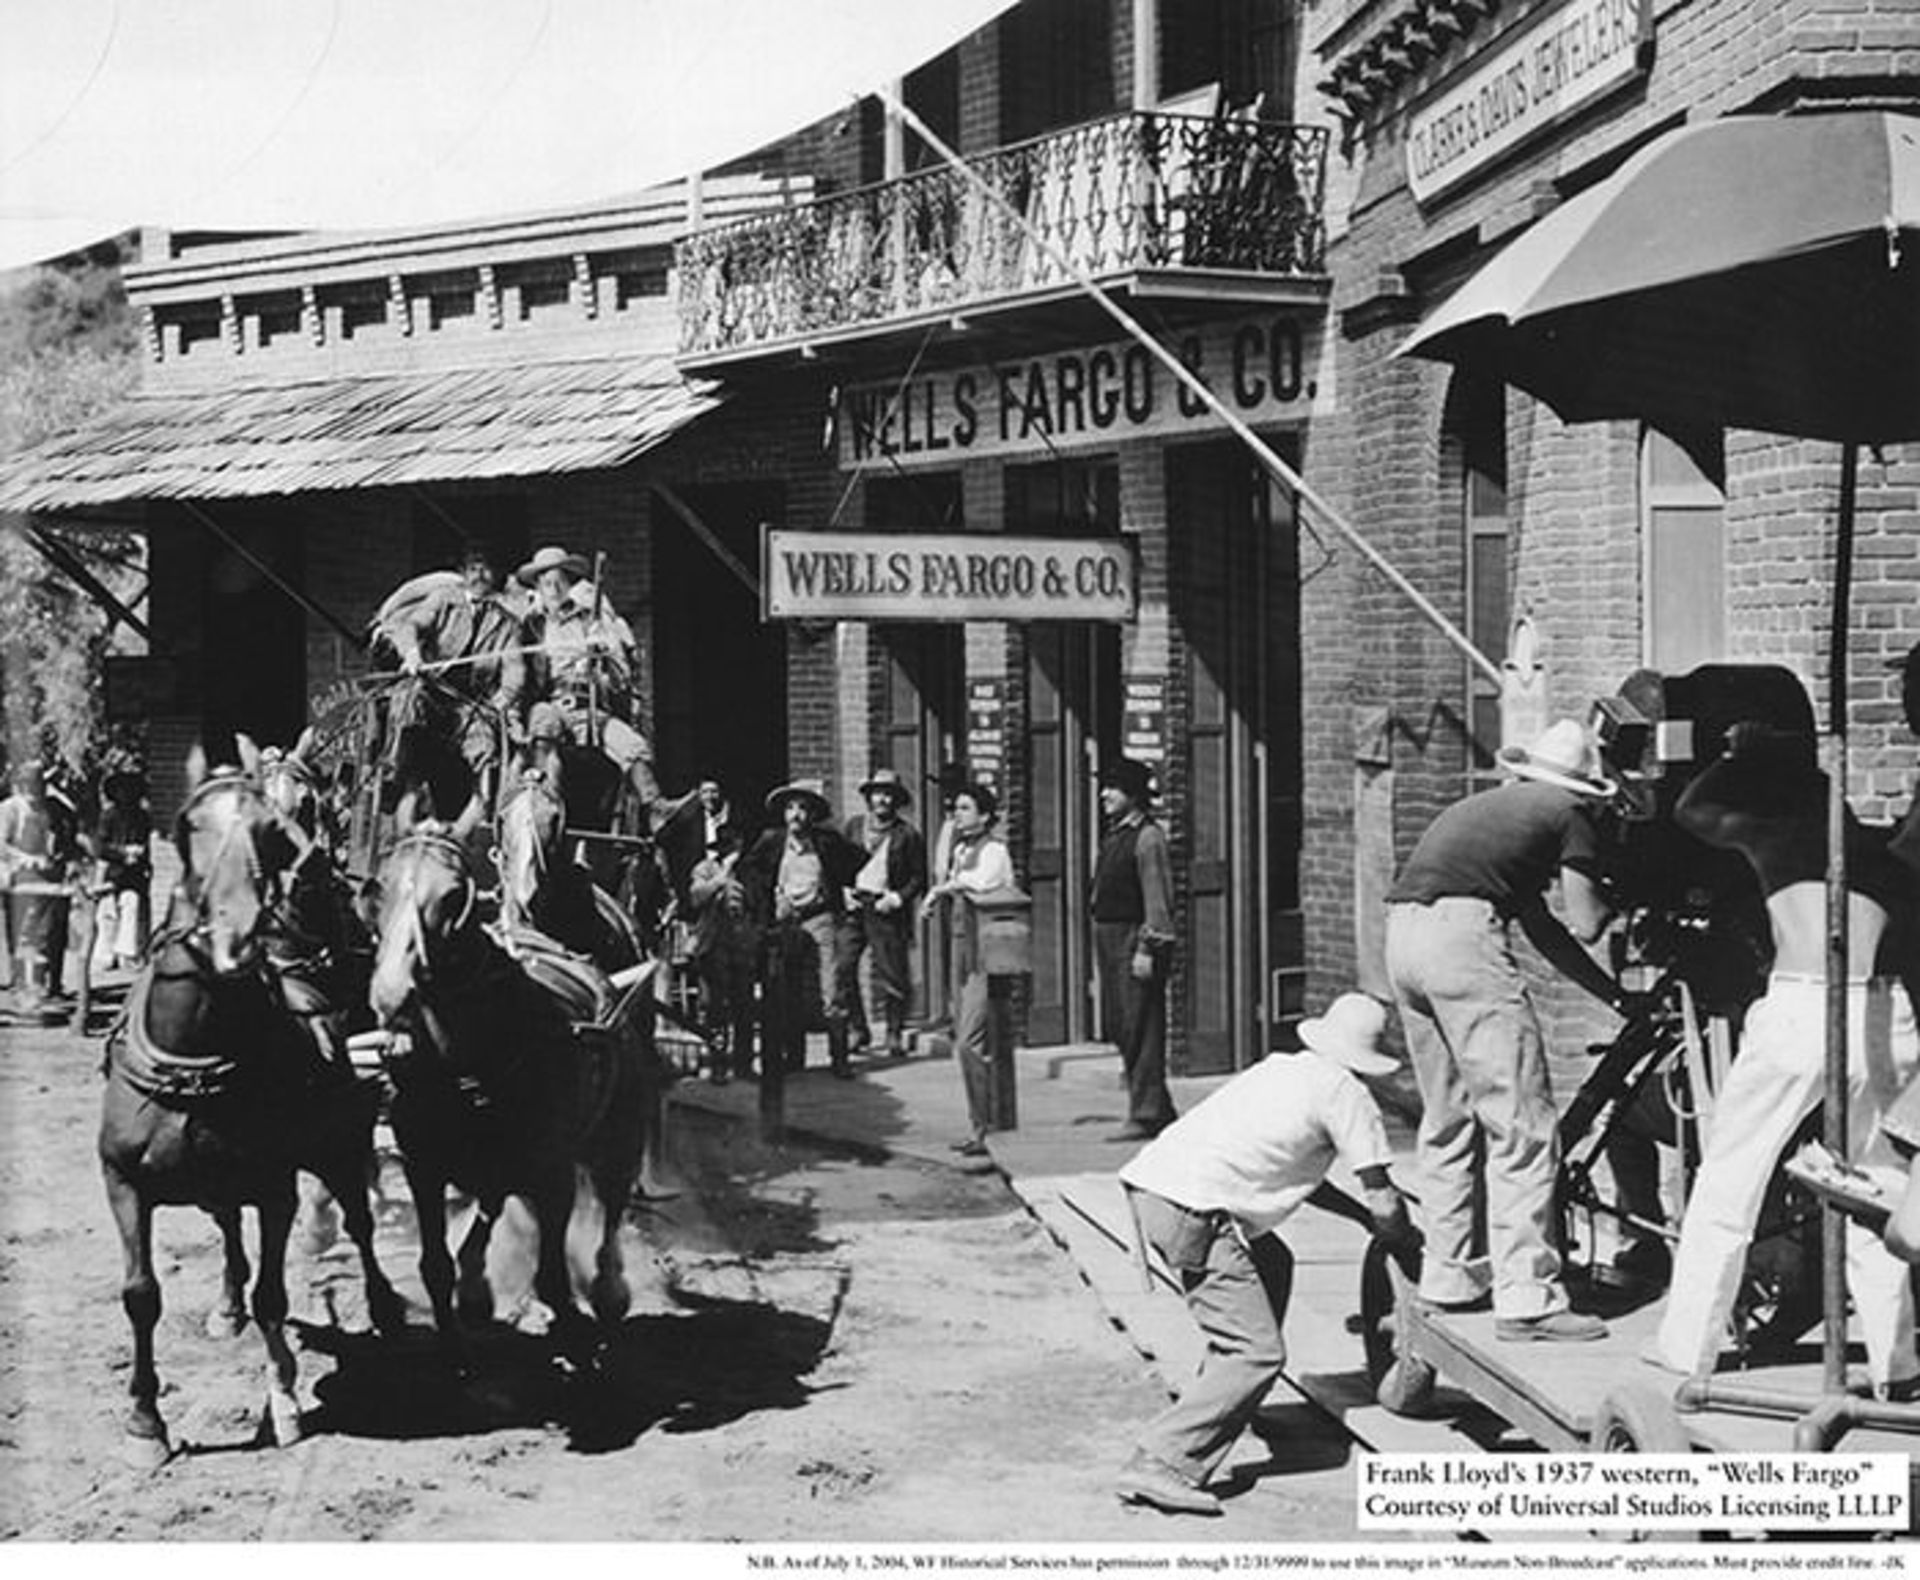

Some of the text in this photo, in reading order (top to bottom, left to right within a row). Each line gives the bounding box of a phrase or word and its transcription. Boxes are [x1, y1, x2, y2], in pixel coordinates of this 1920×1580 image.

[1467, 101, 1480, 148] &
[1480, 59, 1528, 139] DAVIS
[846, 316, 1318, 461] WELLS FARGO & CO.
[780, 550, 1126, 599] WELLS FARGO & CO.
